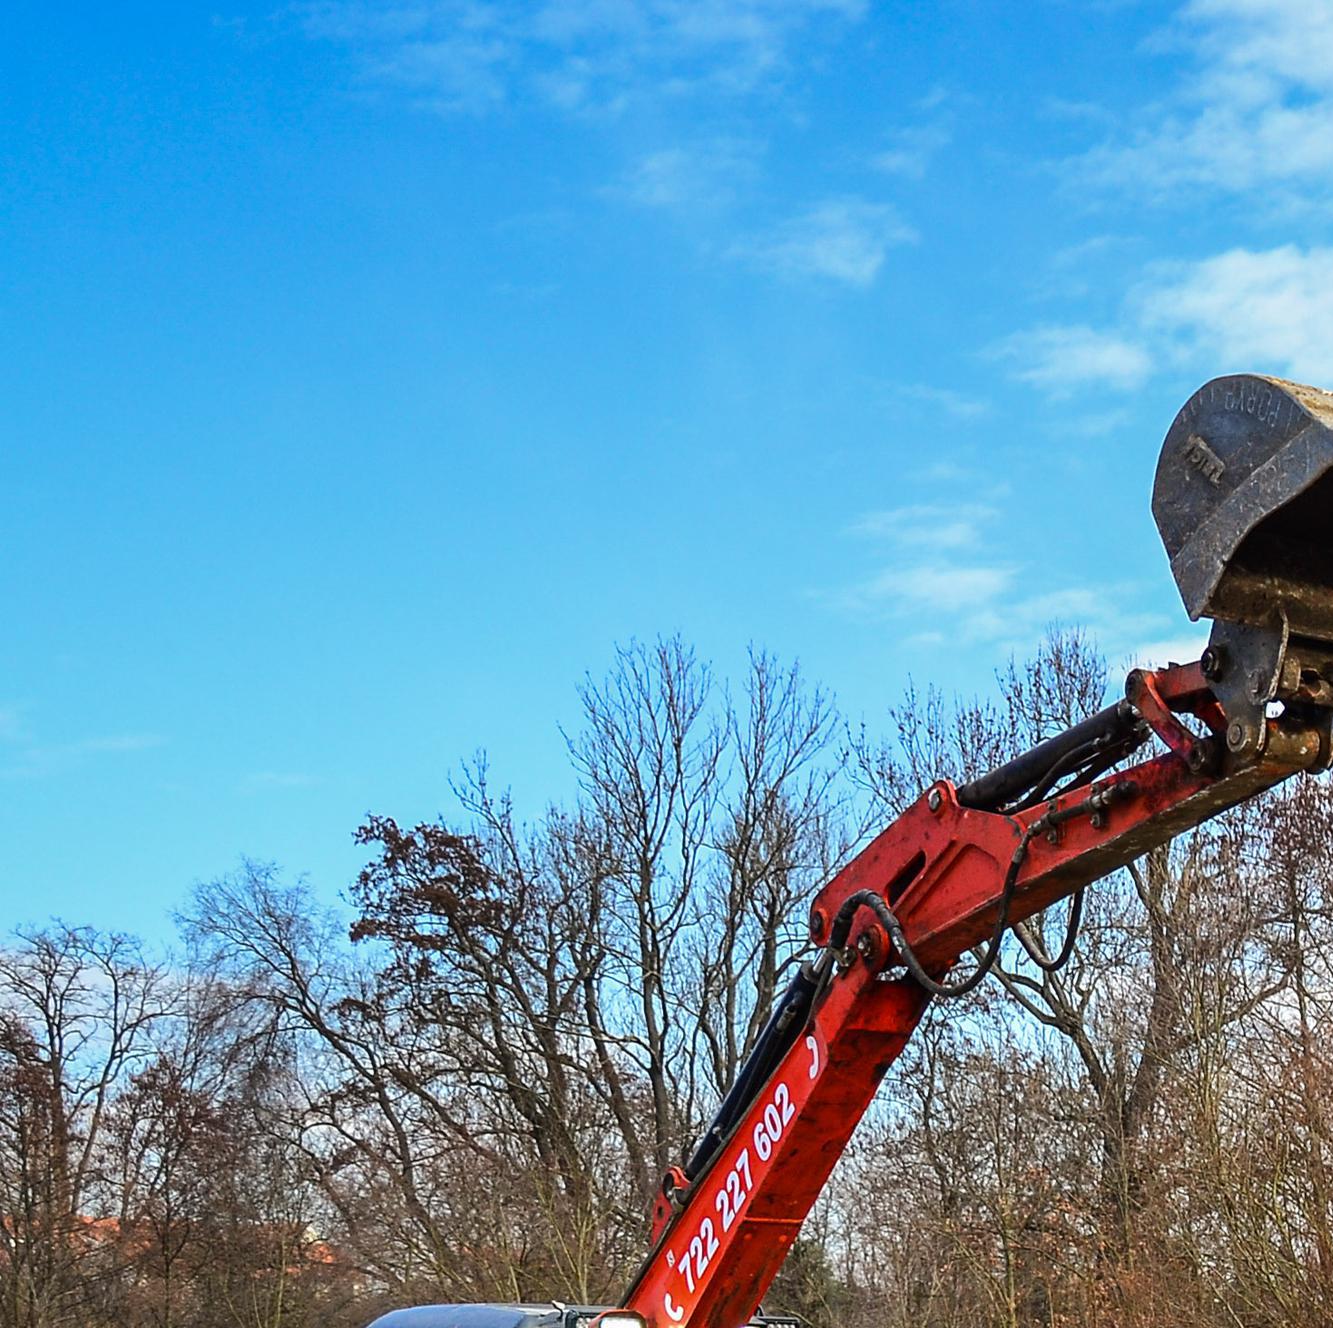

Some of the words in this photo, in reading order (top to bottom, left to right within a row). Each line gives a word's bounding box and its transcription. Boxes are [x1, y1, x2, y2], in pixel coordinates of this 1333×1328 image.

[678, 1217, 720, 1293] 722
[715, 1148, 754, 1232] 227
[753, 1083, 796, 1162] 602
